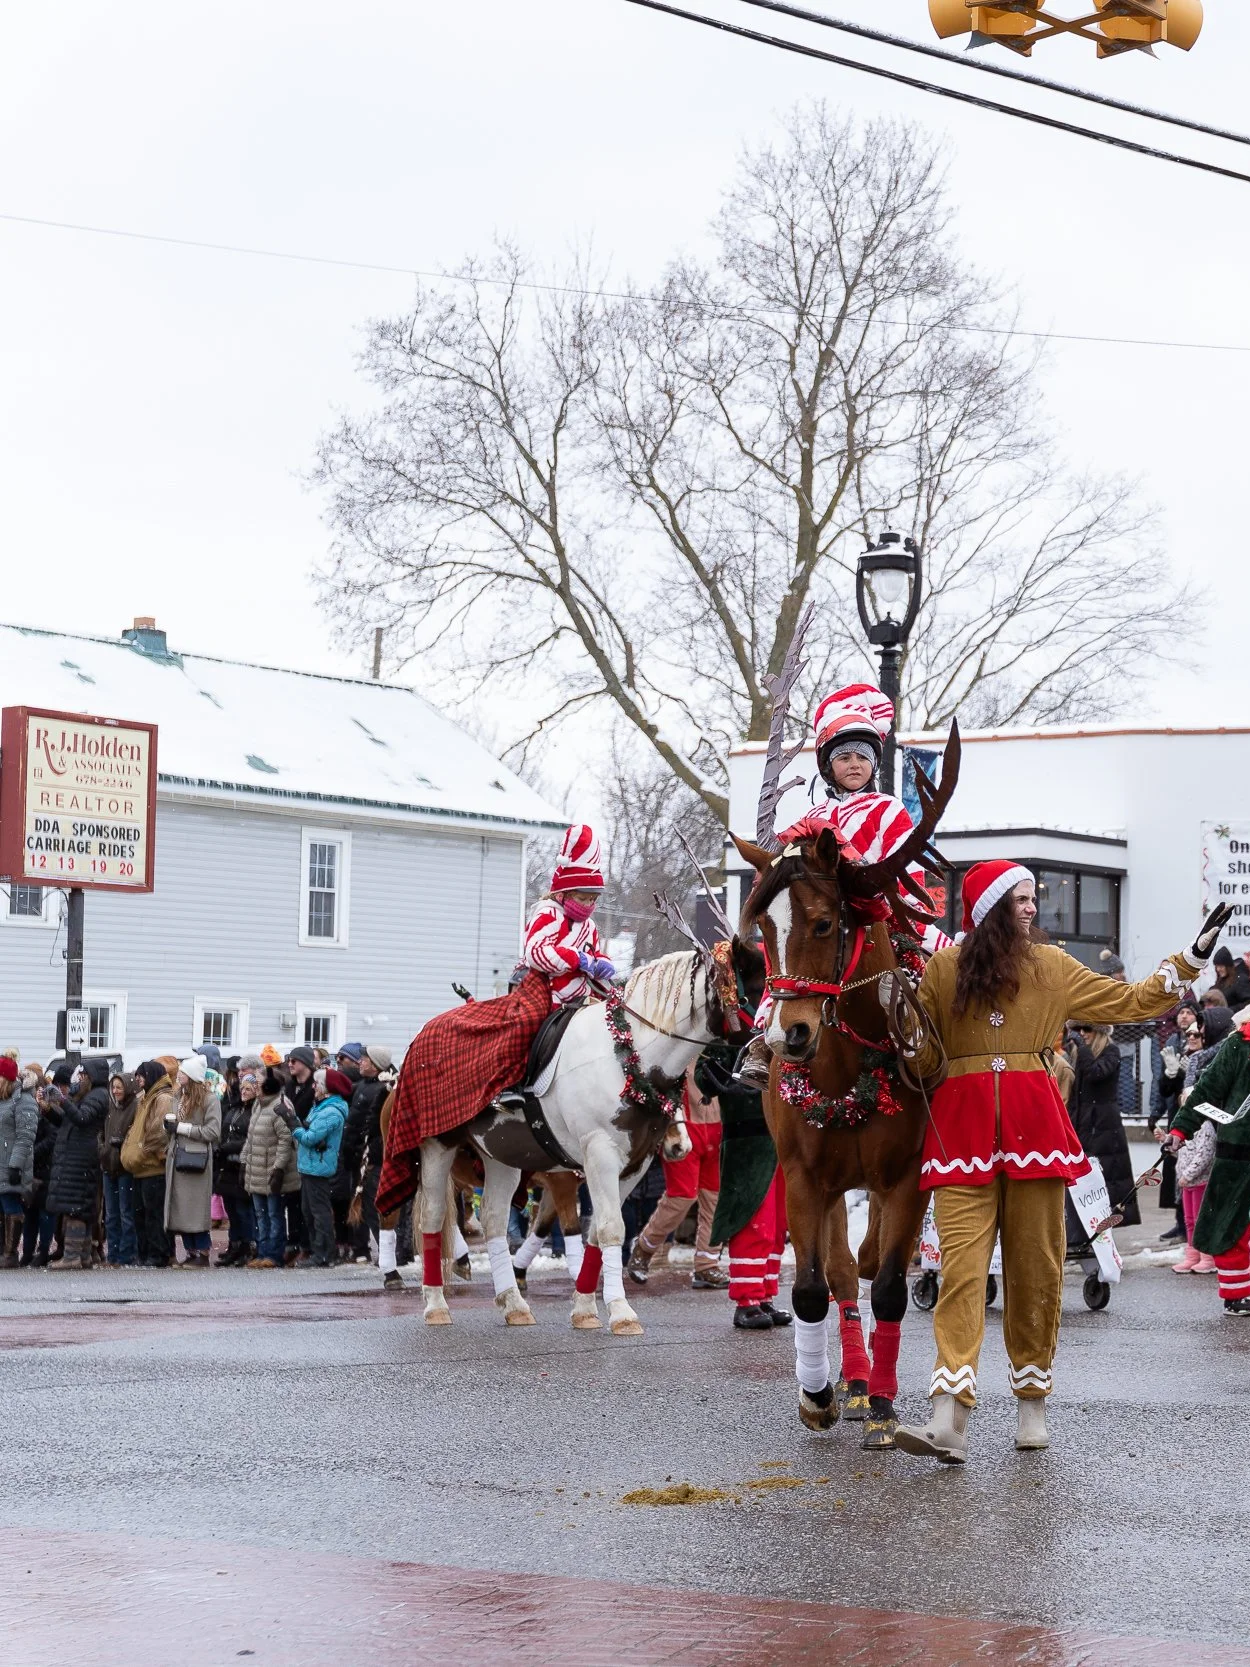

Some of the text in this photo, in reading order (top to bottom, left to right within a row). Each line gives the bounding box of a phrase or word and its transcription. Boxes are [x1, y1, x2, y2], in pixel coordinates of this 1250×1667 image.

[58, 756, 141, 777] & ASSOCIATES
[40, 792, 133, 815] REALTOR
[35, 819, 141, 841] DDA SPONSORED
[27, 836, 135, 858] CARRIAGE RIDES
[30, 854, 134, 876] 12 13 19 20
[1218, 881, 1237, 895] for
[71, 1015, 86, 1023] ONE
[71, 1025, 86, 1033] WAY
